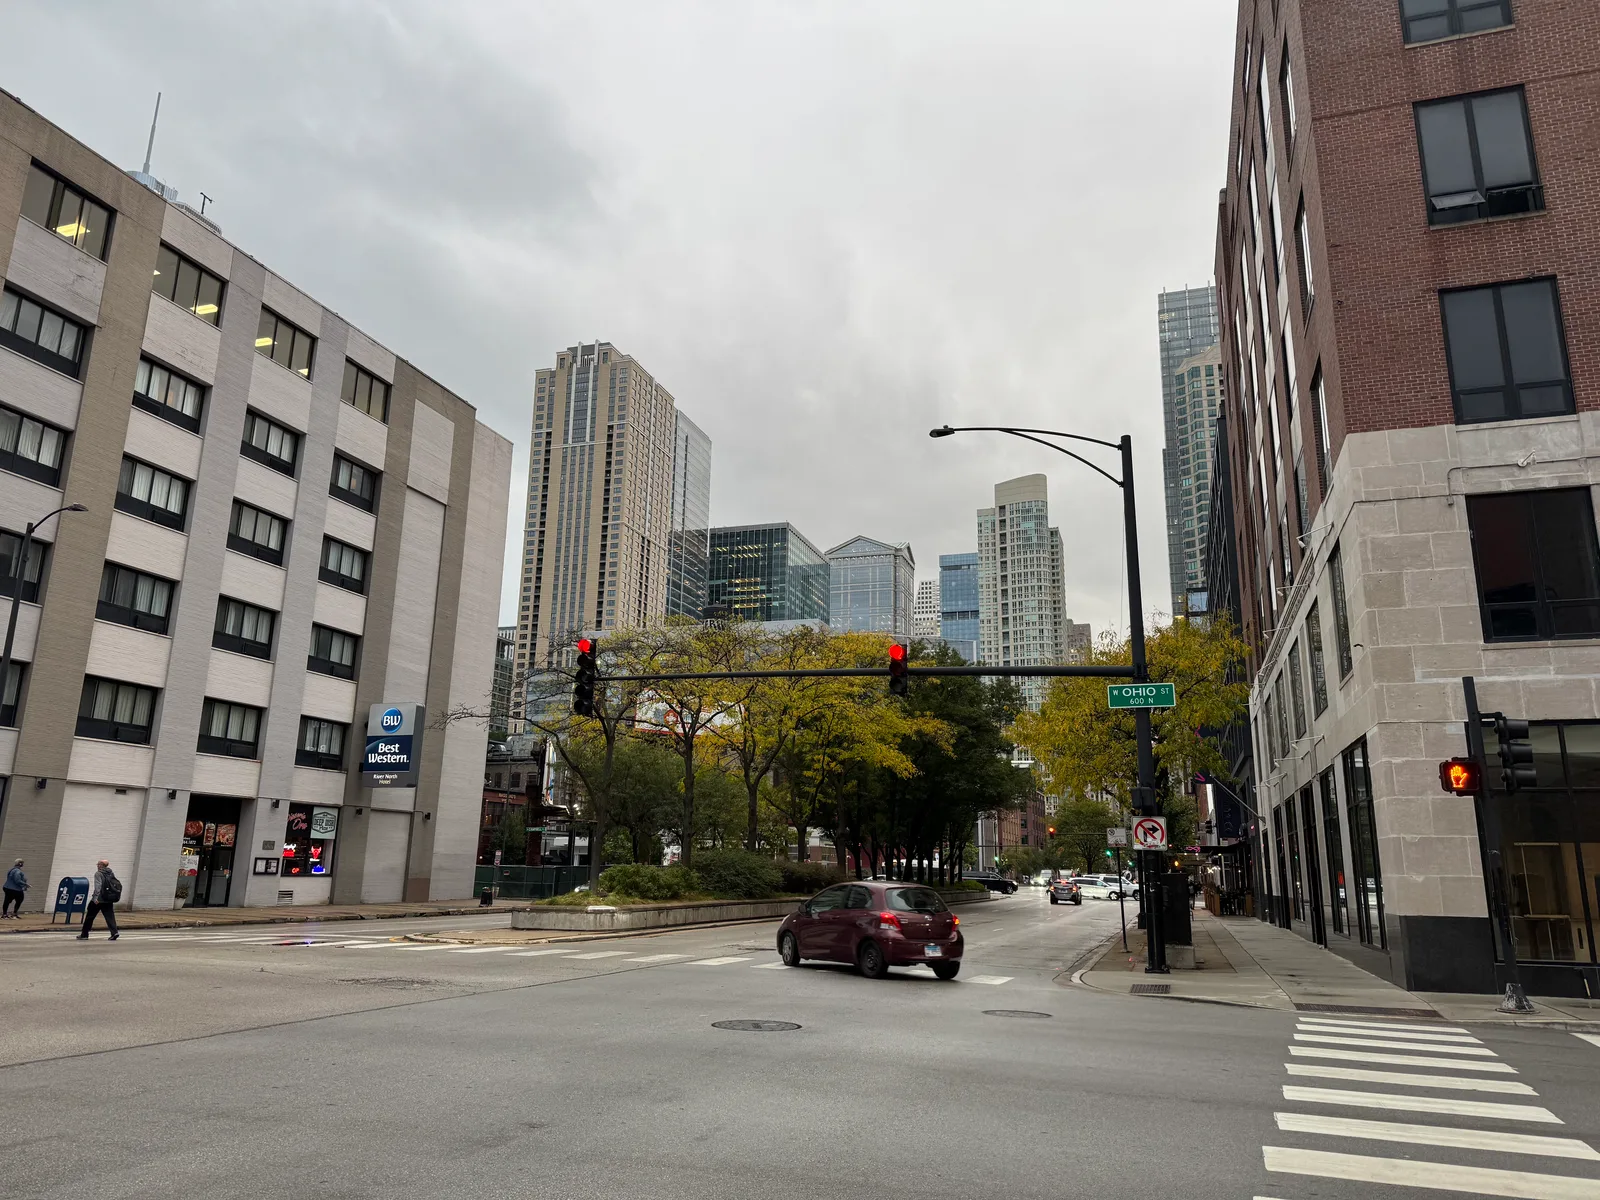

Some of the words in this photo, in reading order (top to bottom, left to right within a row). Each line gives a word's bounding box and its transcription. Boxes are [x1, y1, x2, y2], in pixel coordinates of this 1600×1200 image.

[1122, 687, 1156, 696] OHIO
[383, 716, 401, 726] BW
[378, 743, 400, 753] Best
